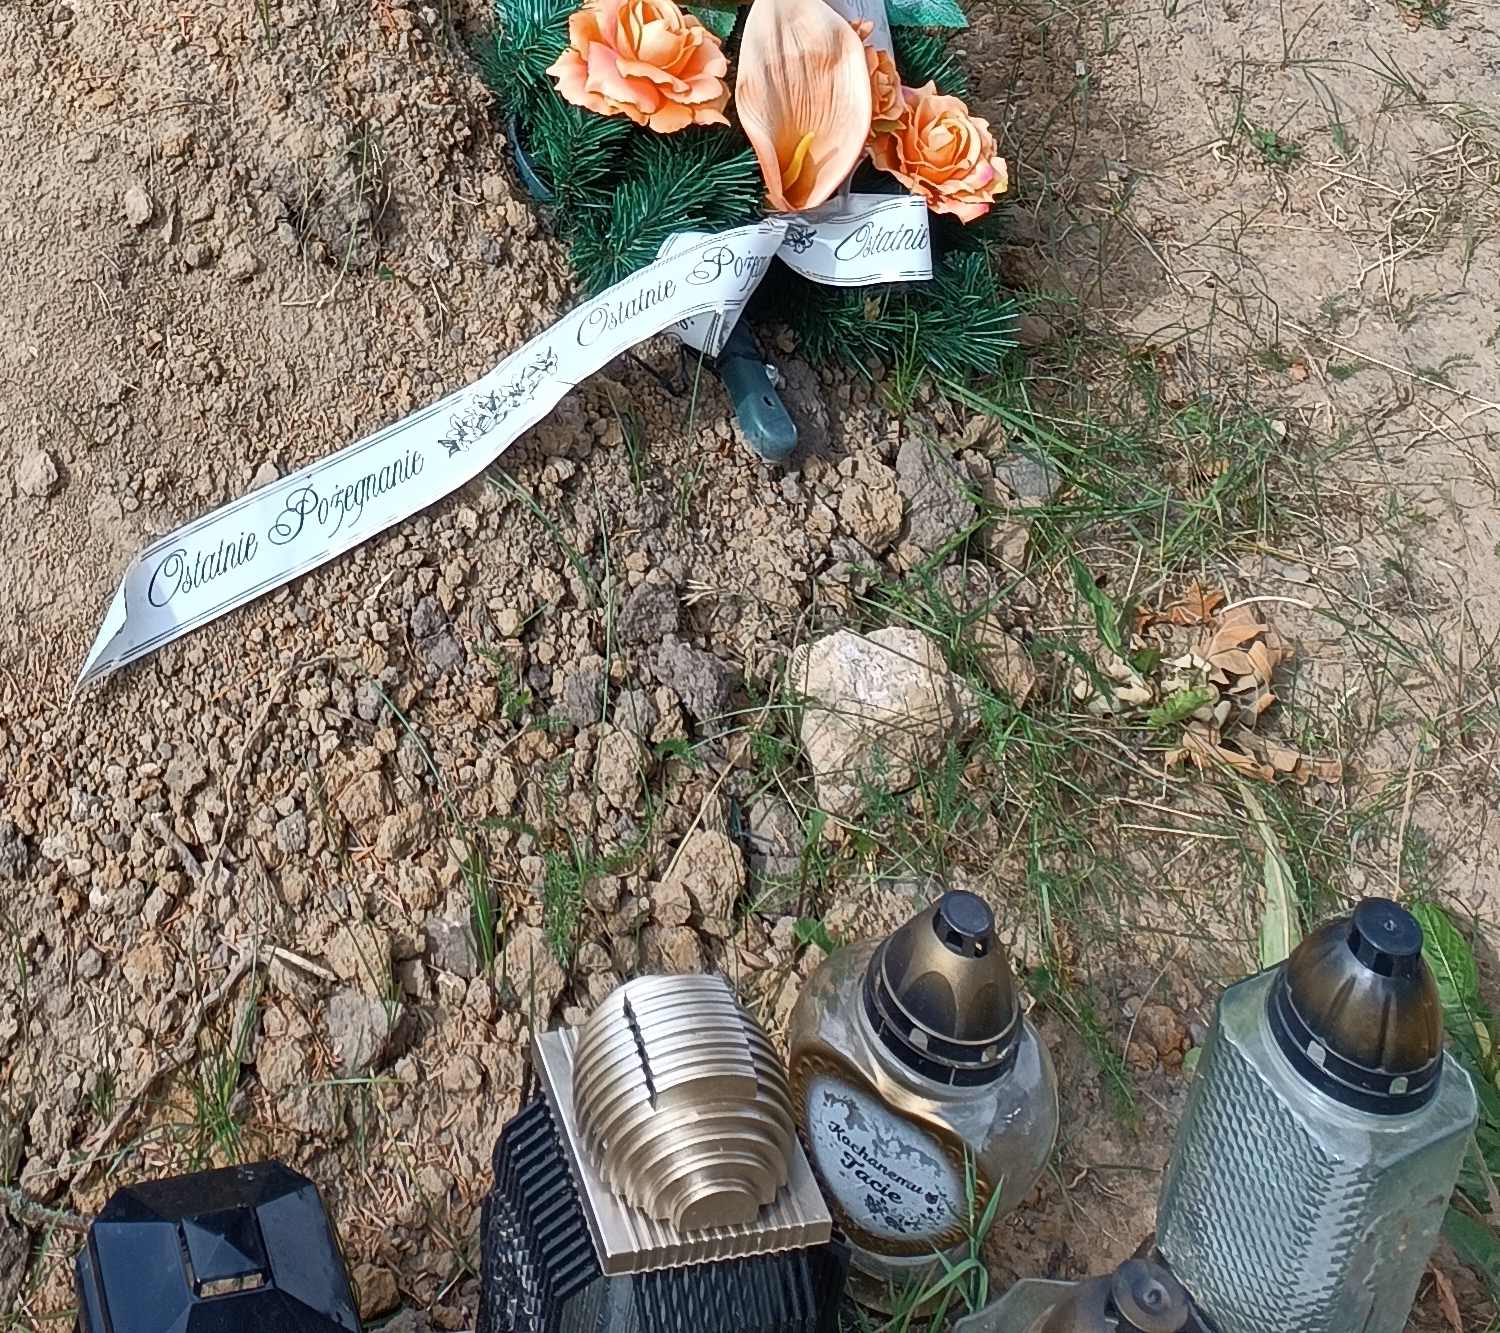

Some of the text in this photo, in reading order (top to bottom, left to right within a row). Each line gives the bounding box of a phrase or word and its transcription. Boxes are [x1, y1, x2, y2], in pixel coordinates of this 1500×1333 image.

[576, 278, 677, 348] Ostatnie
[148, 449, 425, 608] Ostatnie Pożegnanie
[828, 1120, 924, 1195] Kochanemu
[840, 1151, 904, 1205] Tacie
